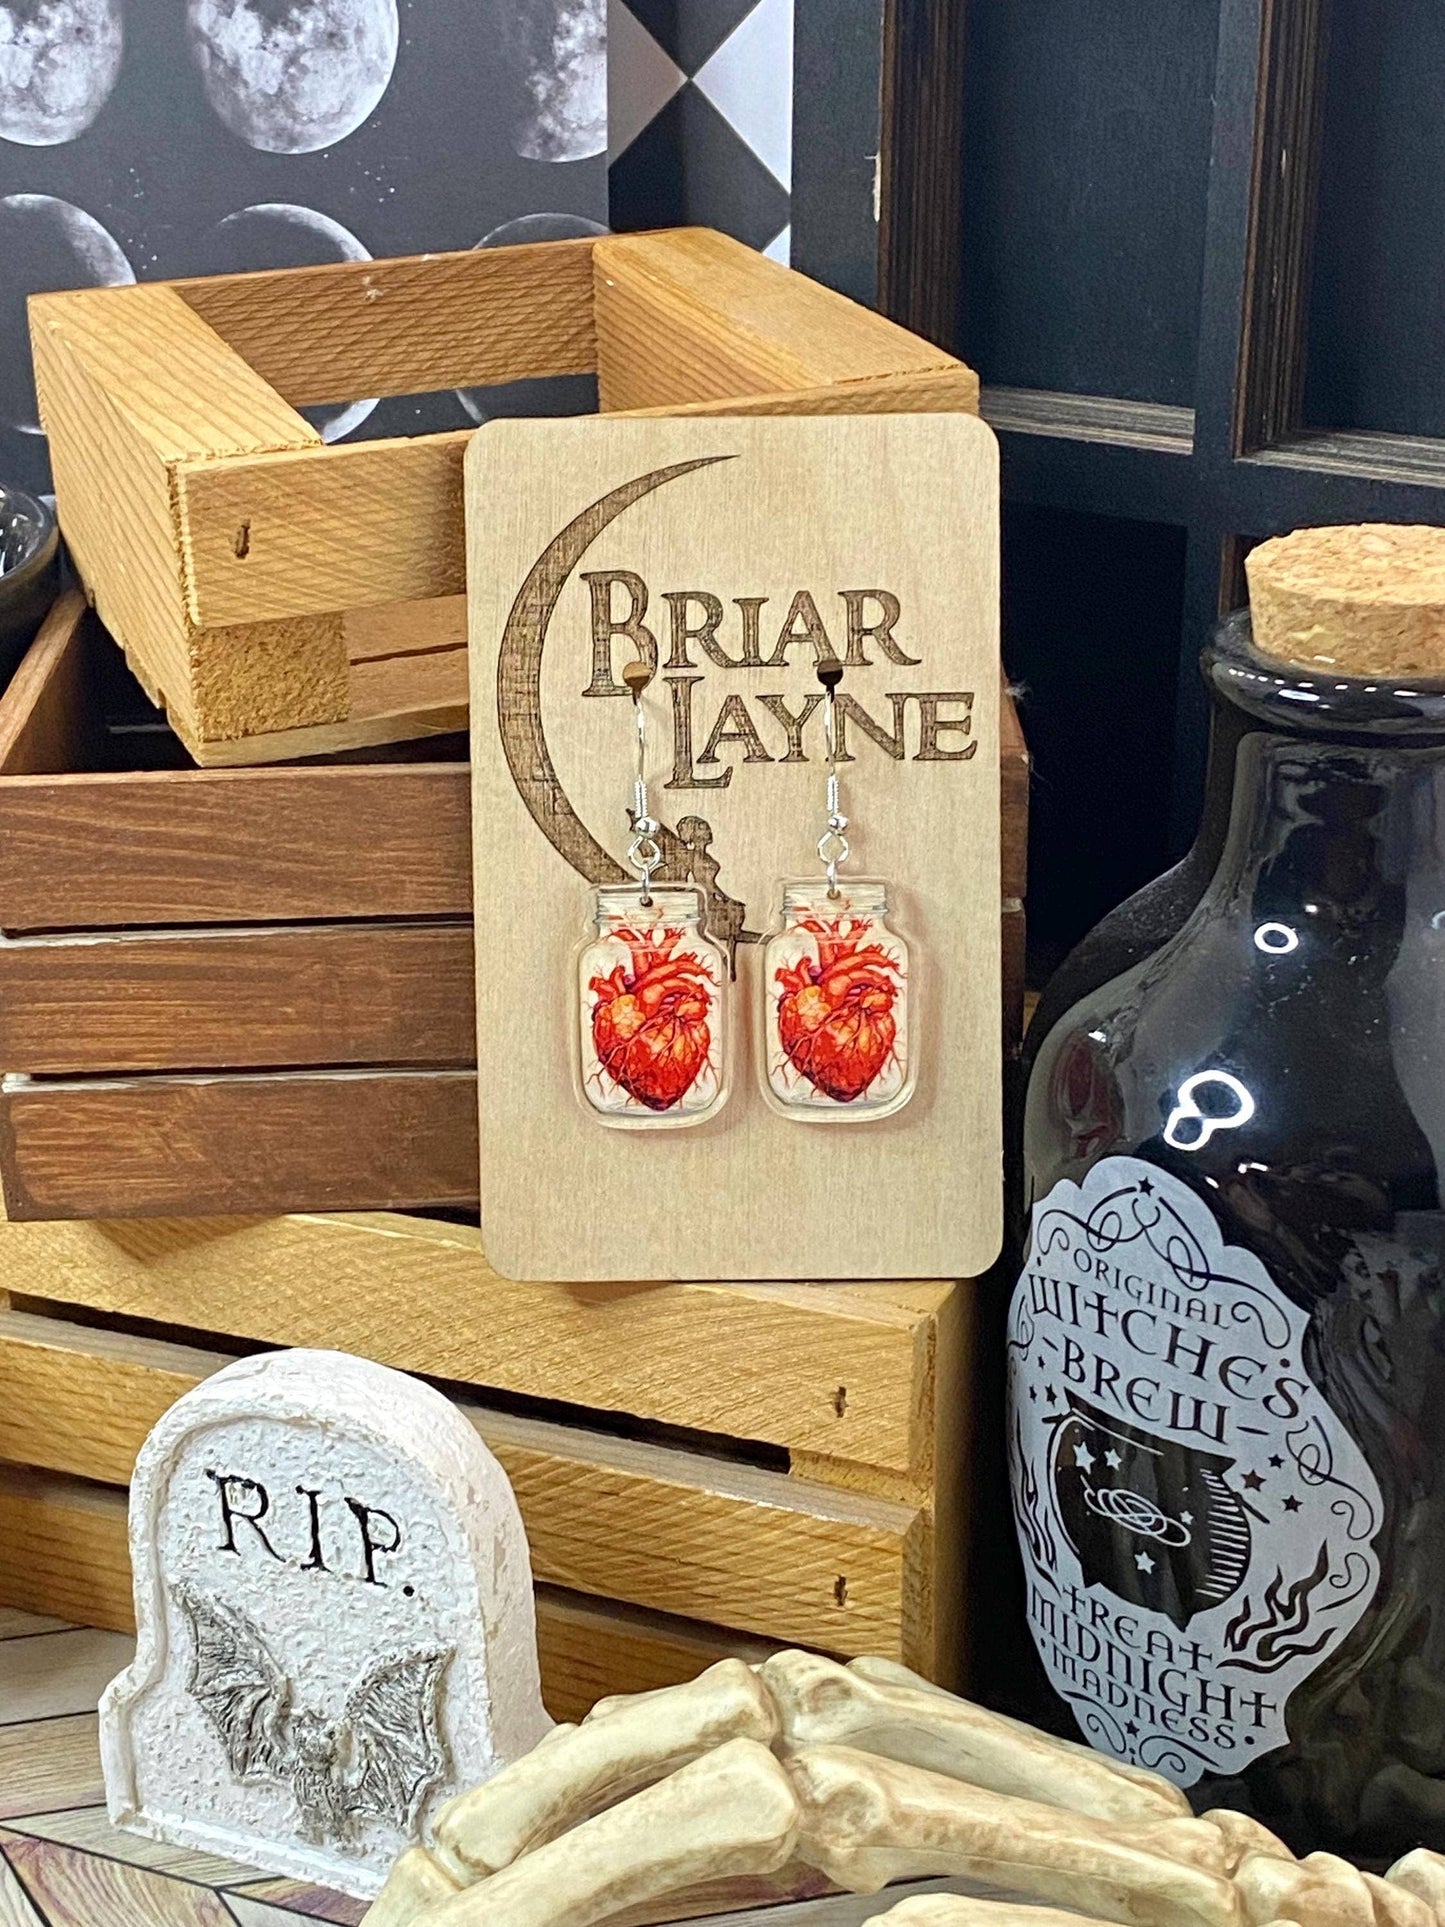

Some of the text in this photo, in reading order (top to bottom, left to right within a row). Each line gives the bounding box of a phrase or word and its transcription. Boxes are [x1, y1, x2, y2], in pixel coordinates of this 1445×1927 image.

[579, 569, 922, 697] BRIAR
[663, 675, 978, 790] LAYNE
[1028, 1273, 1310, 1420] WITCHES
[1073, 1248, 1231, 1330] ORIGINAL
[1030, 1581, 1277, 1729] MIDNIGHT
